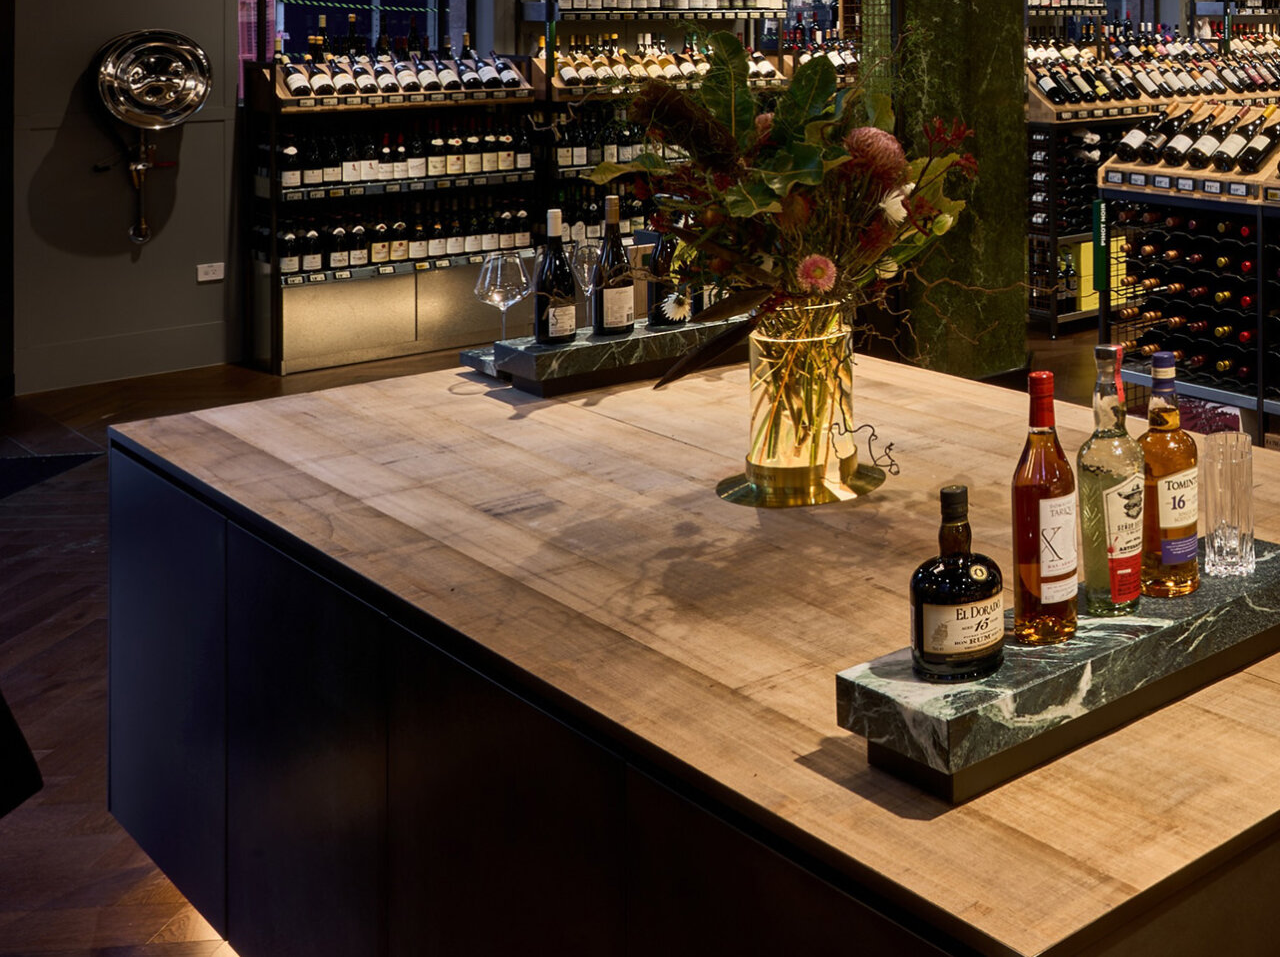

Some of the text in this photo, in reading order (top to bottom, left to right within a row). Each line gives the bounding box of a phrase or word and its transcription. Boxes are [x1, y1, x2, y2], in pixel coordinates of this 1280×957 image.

[1171, 494, 1186, 510] 16
[956, 608, 969, 621] EL
[974, 617, 990, 632] 15
[969, 633, 991, 645] RUM
